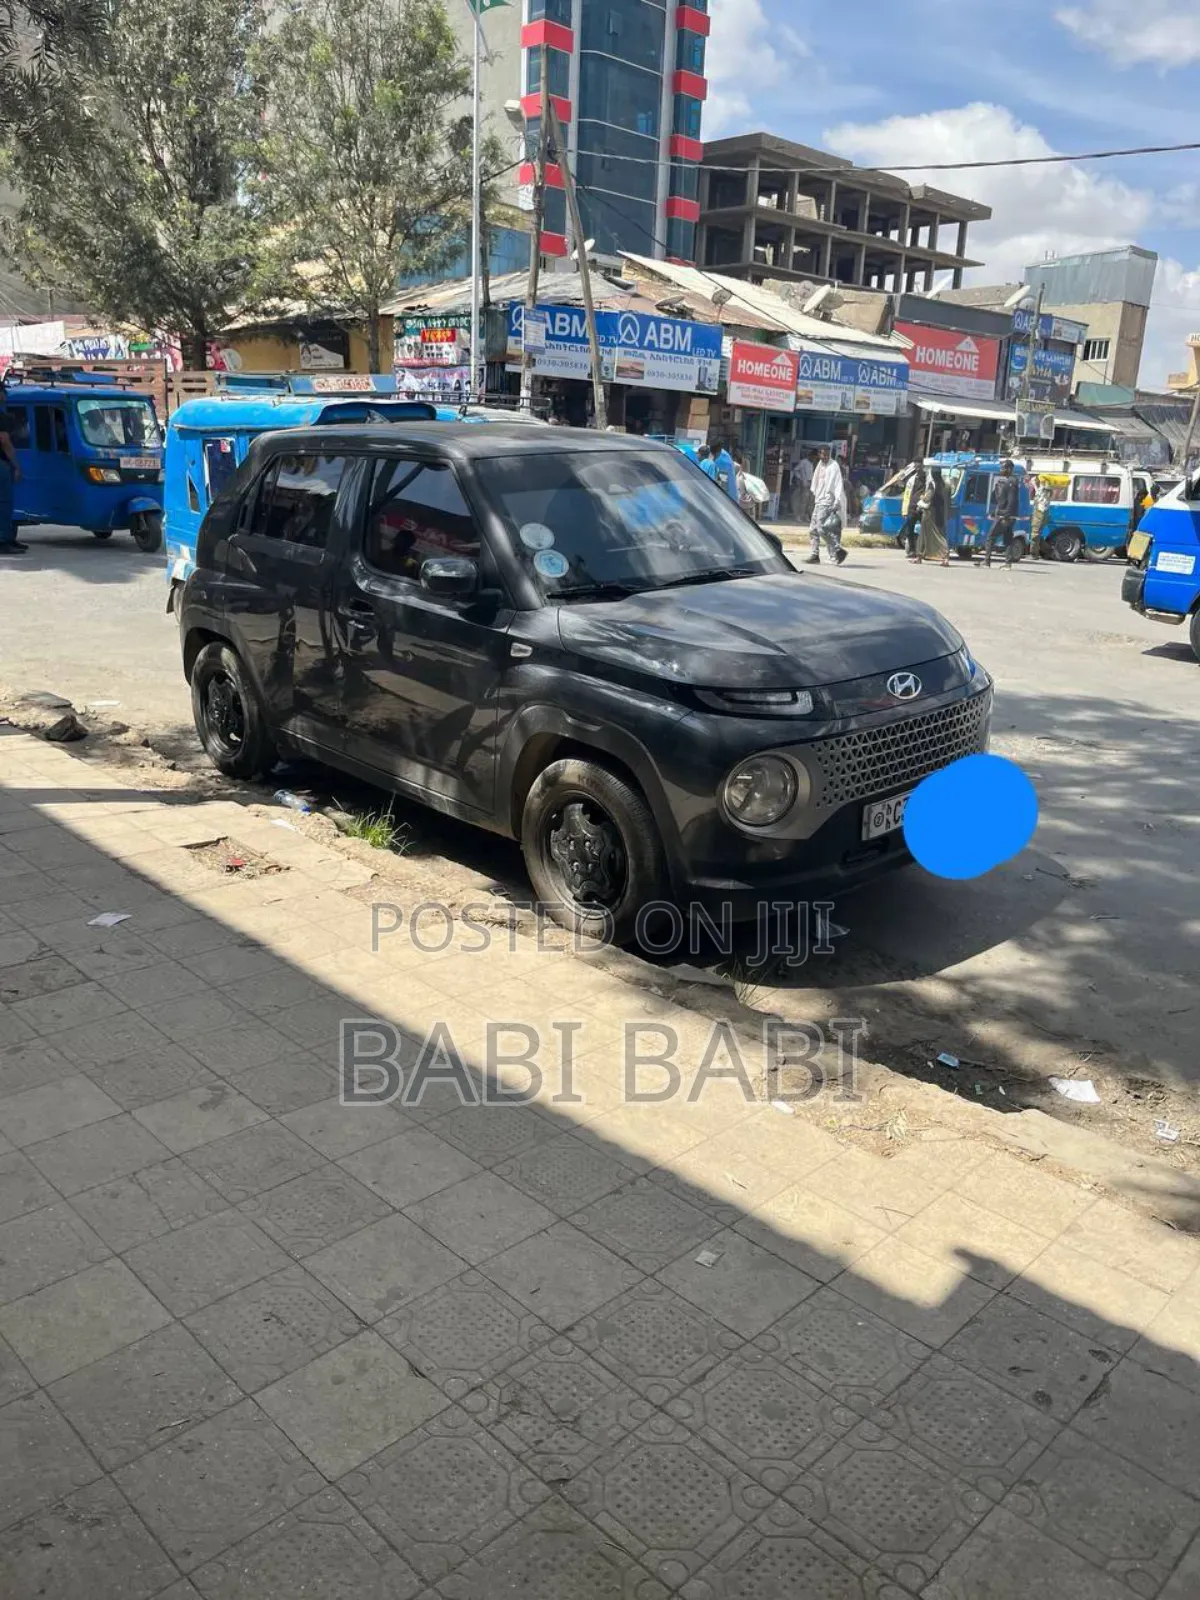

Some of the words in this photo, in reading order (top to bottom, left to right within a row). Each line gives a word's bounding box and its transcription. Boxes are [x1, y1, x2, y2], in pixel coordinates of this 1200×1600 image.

[643, 321, 692, 352] ABM
[915, 346, 980, 371] HOMEONE
[737, 360, 793, 381] HOMEONE
[812, 359, 842, 380] ABM
[870, 366, 896, 386] ABM
